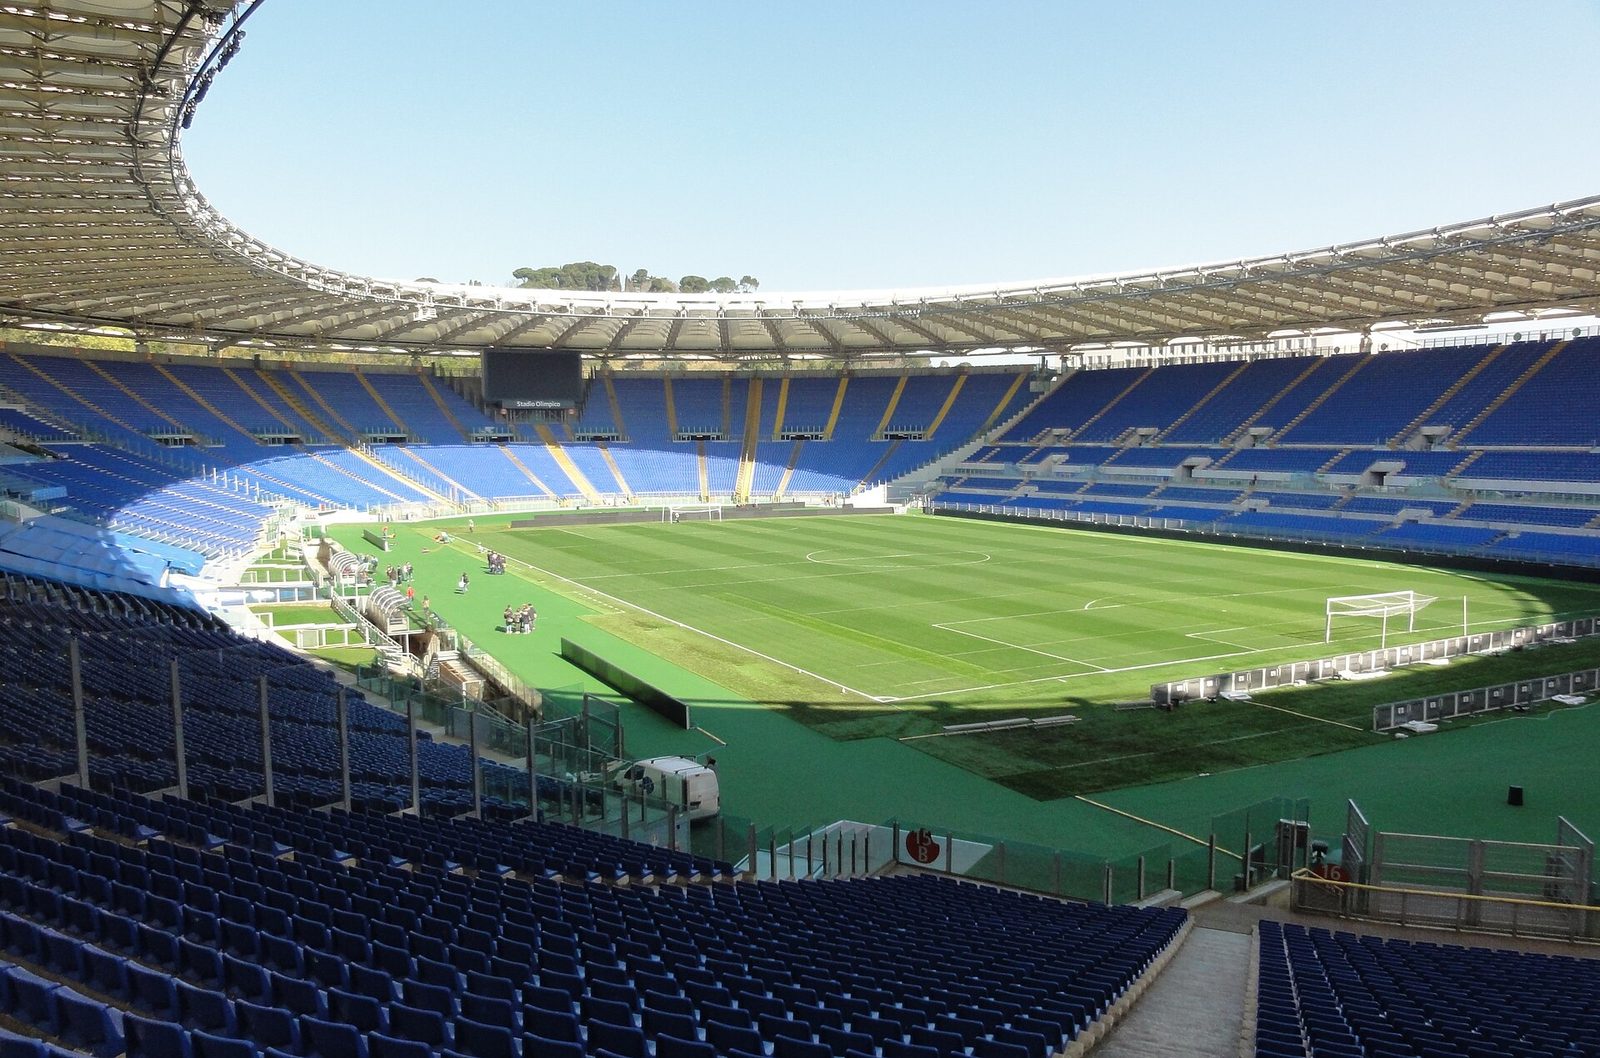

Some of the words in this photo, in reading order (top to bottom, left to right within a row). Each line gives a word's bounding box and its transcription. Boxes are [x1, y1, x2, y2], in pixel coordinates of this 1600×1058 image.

[535, 400, 561, 408] Olimpico
[915, 829, 932, 846] 15
[918, 846, 928, 862] B
[1321, 864, 1341, 881] 16
